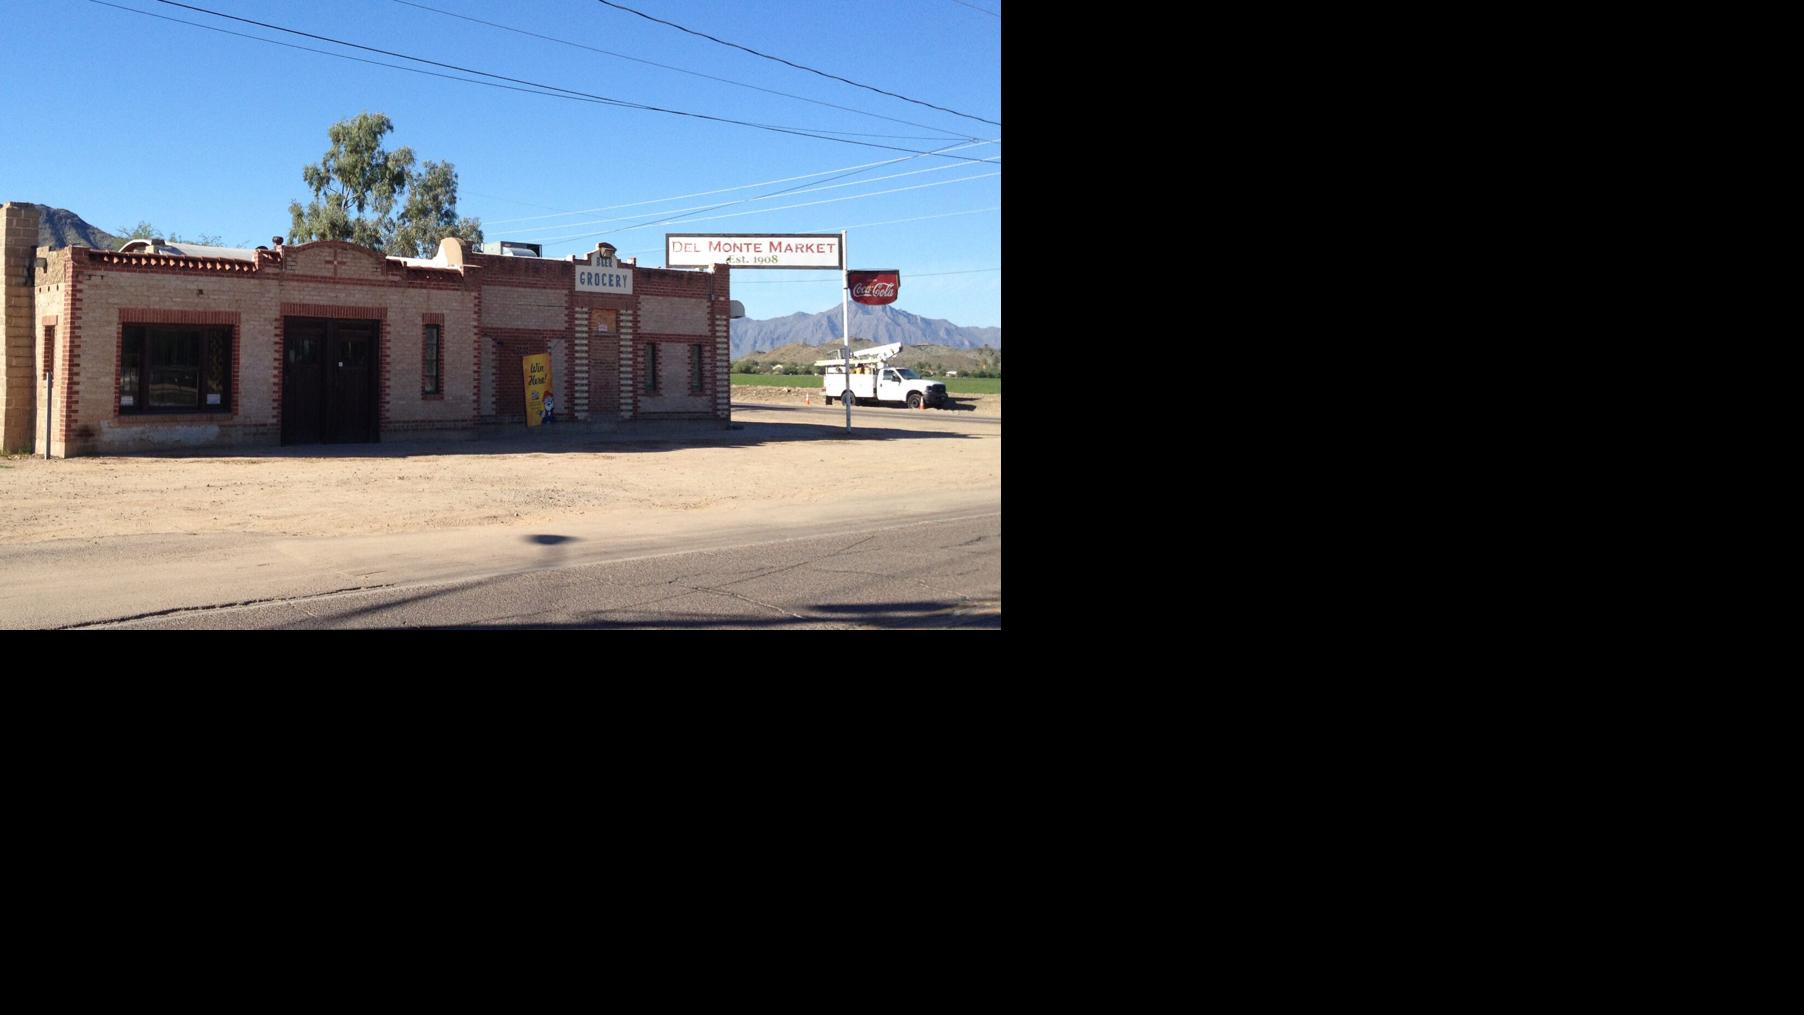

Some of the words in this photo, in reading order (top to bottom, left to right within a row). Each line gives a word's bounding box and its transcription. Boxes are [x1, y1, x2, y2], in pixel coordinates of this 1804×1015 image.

[672, 241, 701, 253] DEL
[708, 240, 762, 253] MONTE
[769, 241, 836, 254] MARKET
[729, 255, 750, 264] Est.
[753, 255, 779, 264] 1908
[579, 271, 628, 289] GROCERY
[530, 362, 545, 373] Win
